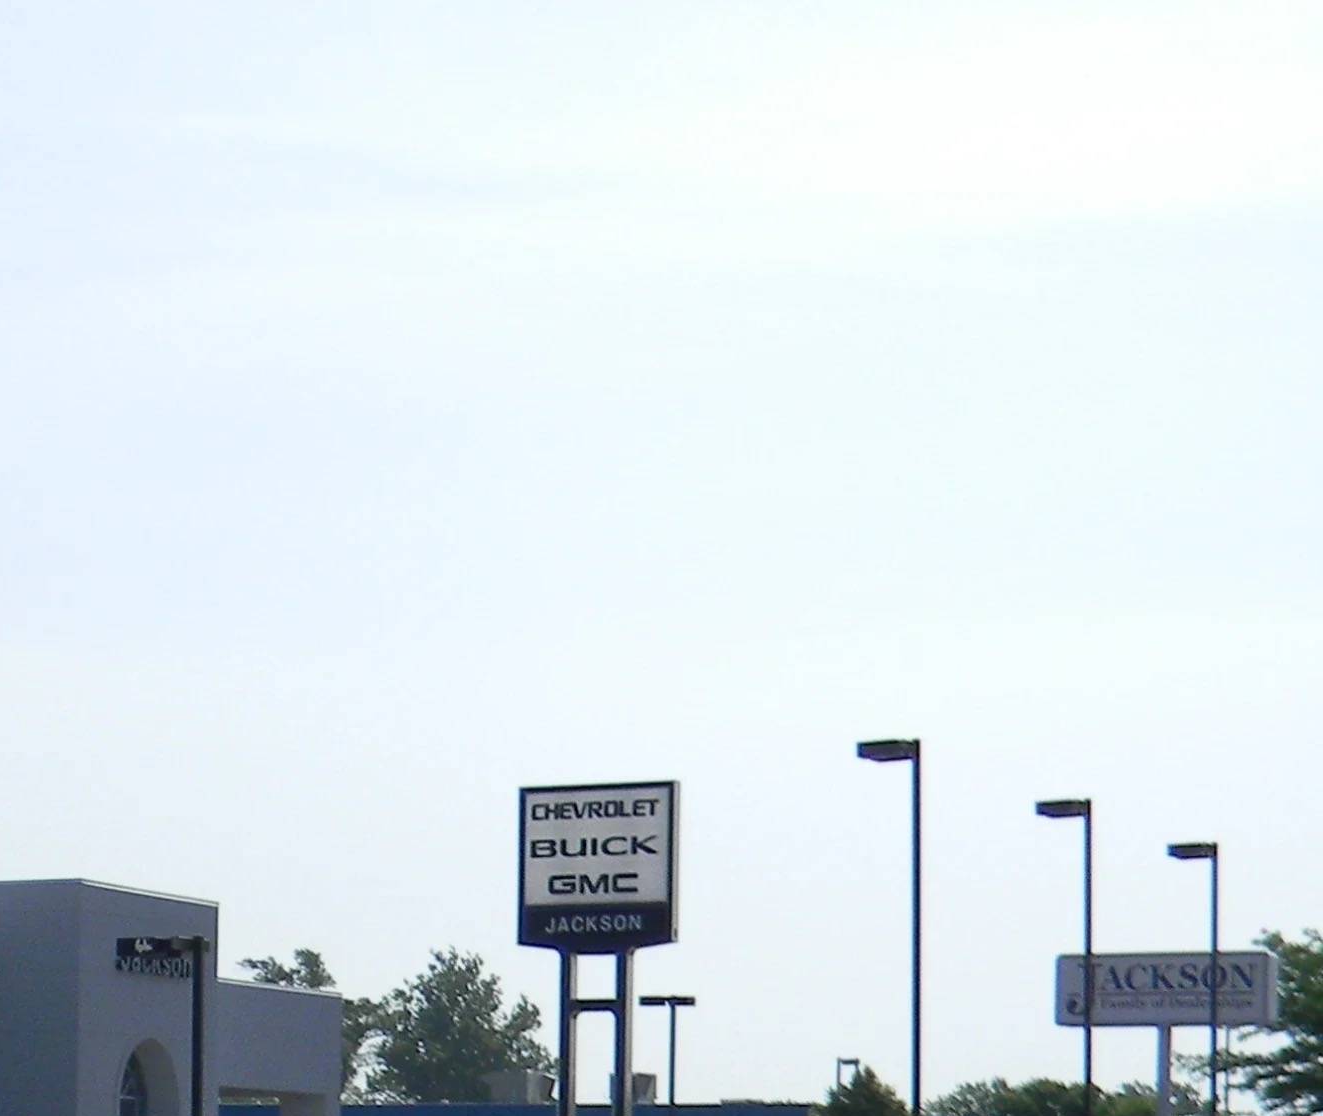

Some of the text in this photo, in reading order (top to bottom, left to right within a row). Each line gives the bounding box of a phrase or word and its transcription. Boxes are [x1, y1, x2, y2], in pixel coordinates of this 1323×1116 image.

[531, 799, 659, 821] CHEVROLET
[530, 835, 657, 858] BUICK
[548, 873, 638, 894] GMC
[545, 914, 642, 934] JACKSON
